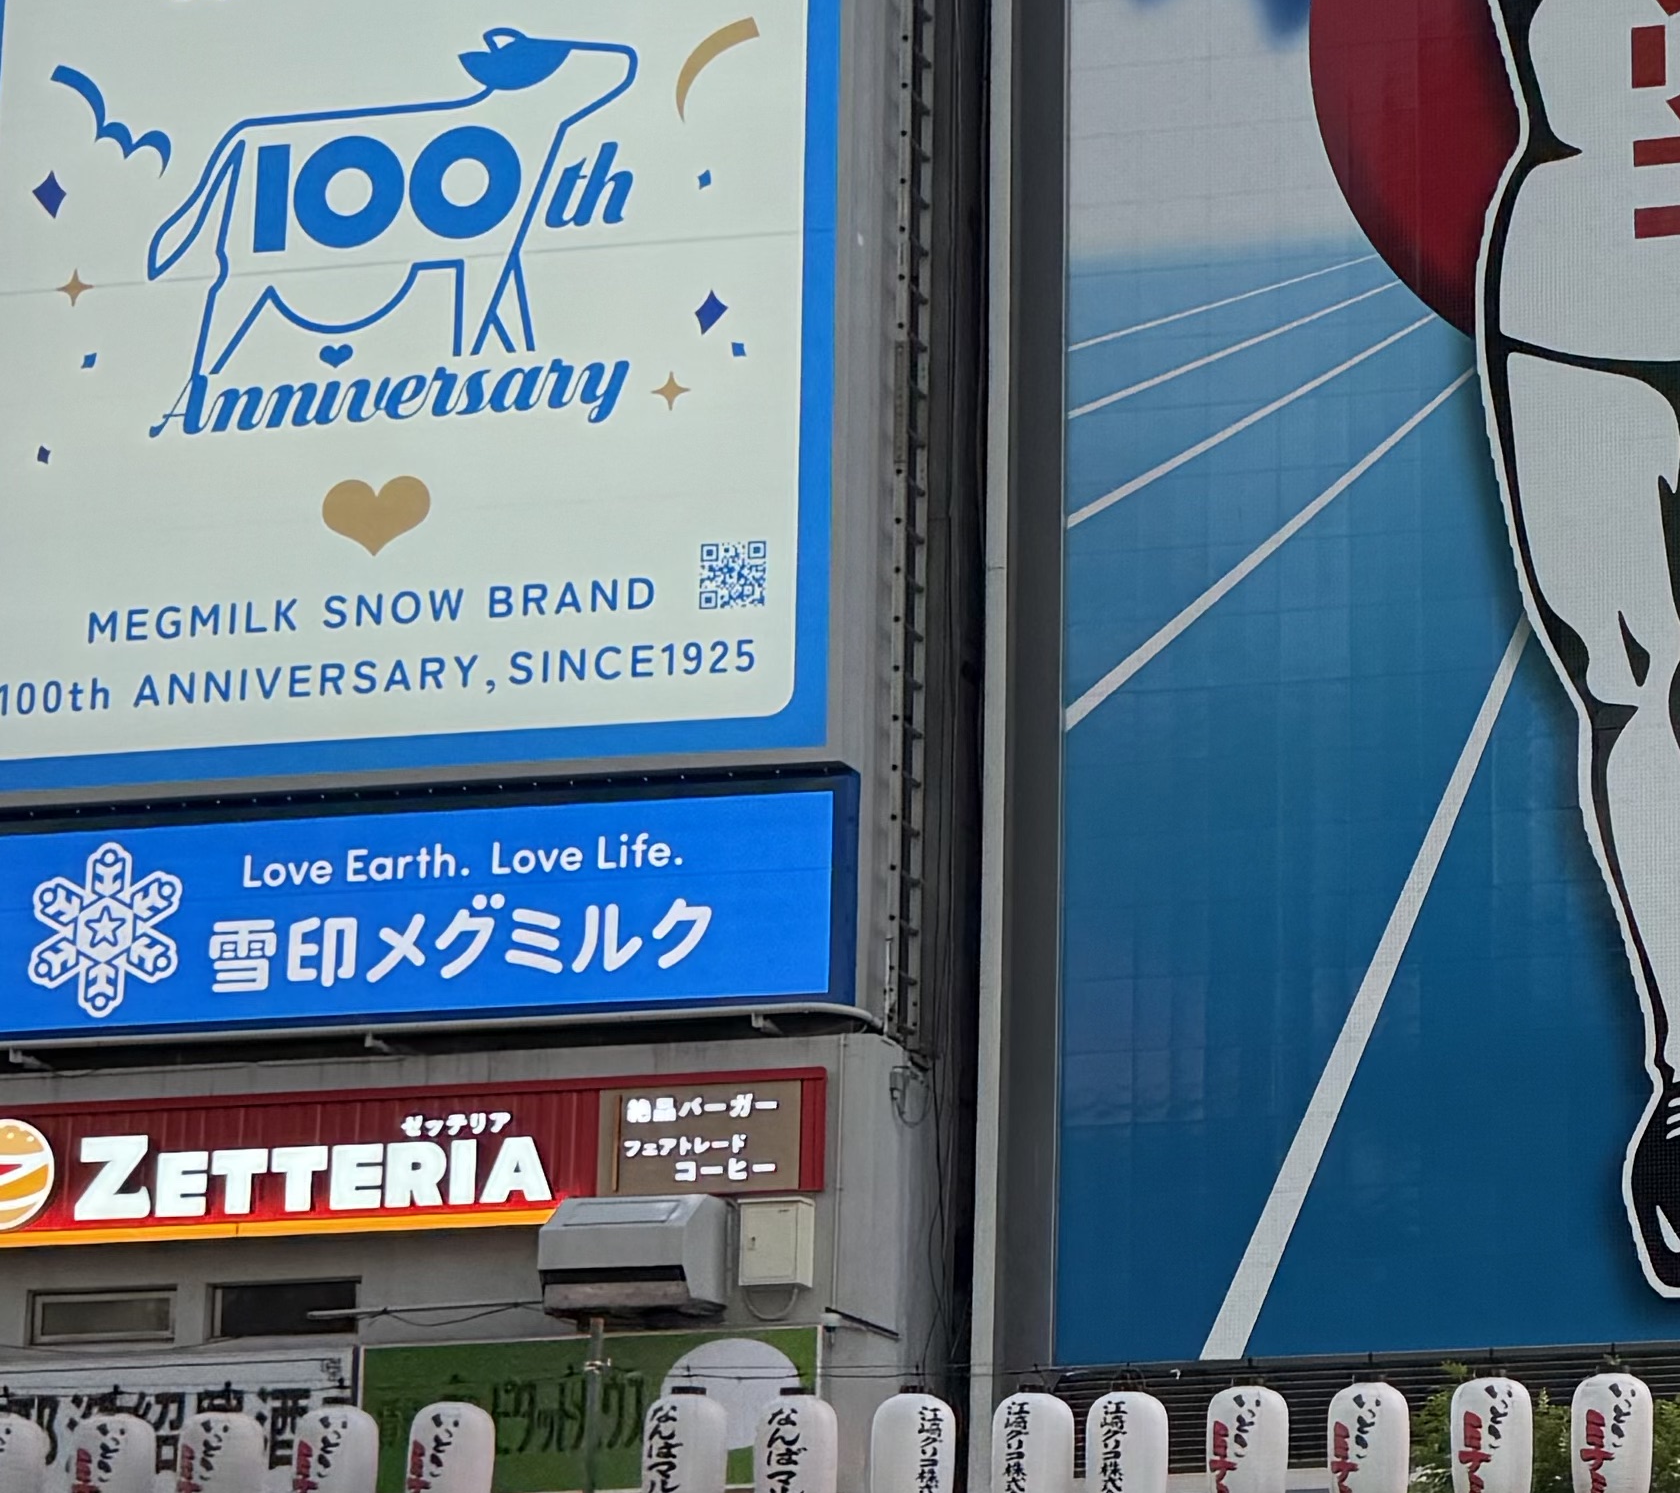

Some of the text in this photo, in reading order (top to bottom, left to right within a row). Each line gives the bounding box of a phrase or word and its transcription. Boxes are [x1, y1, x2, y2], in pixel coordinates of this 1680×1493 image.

[148, 359, 631, 439] Anniversary
[87, 575, 657, 645] MEGMILK SNOW BRAND
[0, 677, 110, 717] 100th
[242, 831, 684, 889] Love Earth. Love Life.
[208, 893, 714, 993] 雪印メグミルク
[400, 1111, 512, 1137] ゼッテリア
[623, 1133, 748, 1158] フェアトレード
[73, 1133, 553, 1222] ZETTERIA
[673, 1157, 777, 1182] コーヒー
